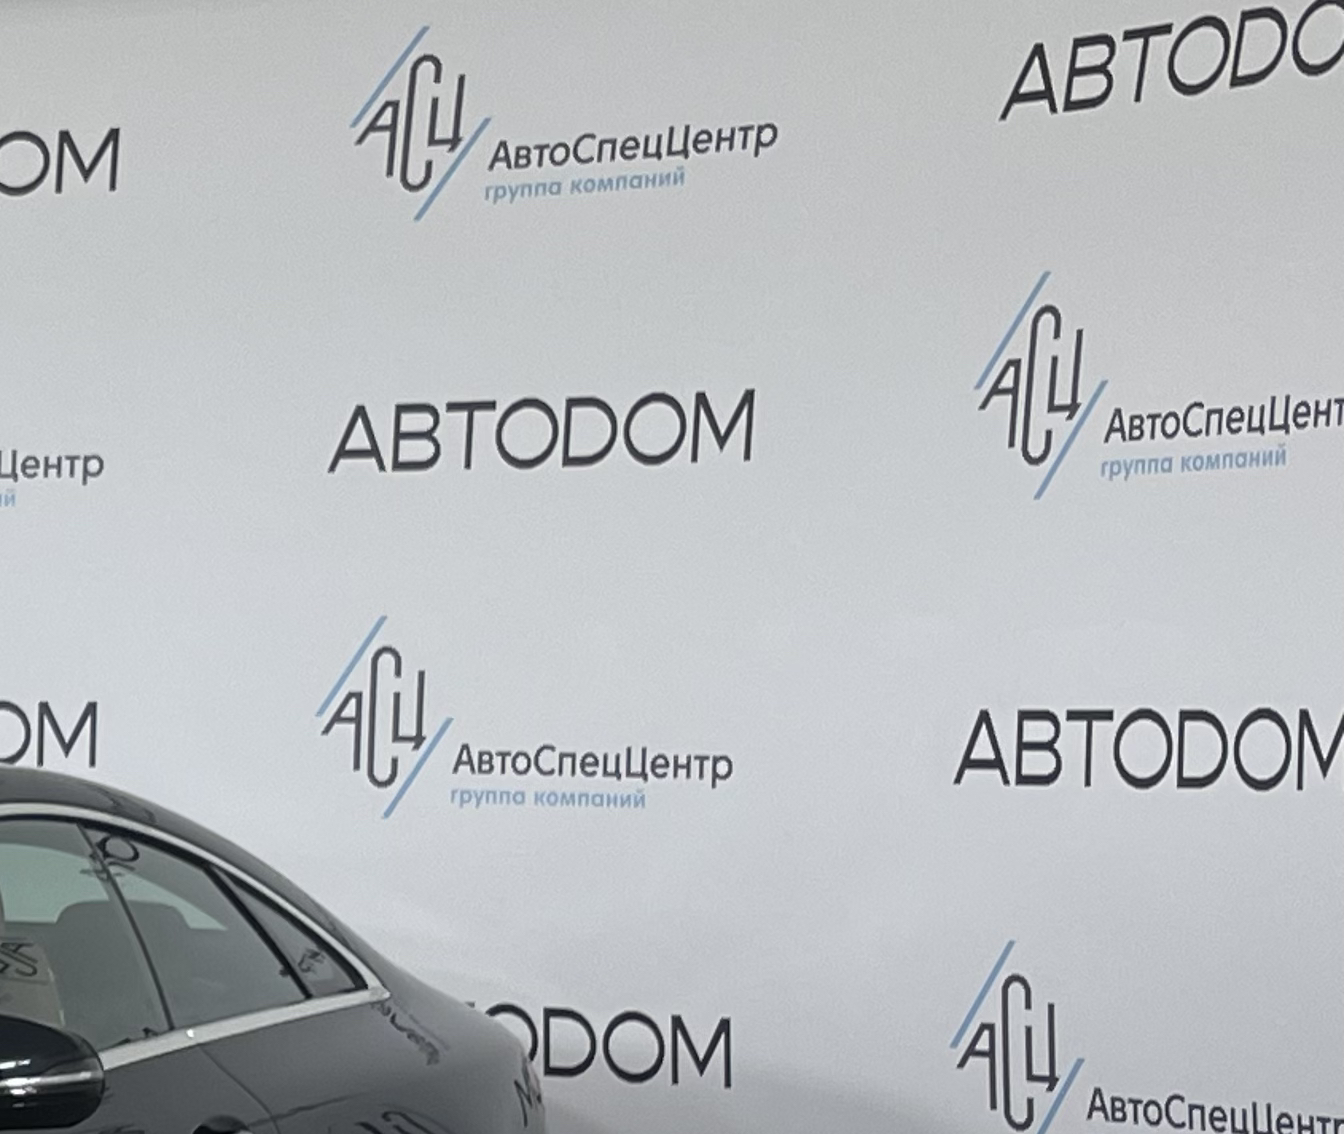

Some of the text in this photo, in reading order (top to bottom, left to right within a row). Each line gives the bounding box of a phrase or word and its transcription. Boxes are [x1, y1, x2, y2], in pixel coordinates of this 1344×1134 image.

[487, 122, 779, 172] АвтоСпецЦентр
[484, 166, 687, 204] группа компаний
[327, 388, 756, 474] ABTODOM
[1100, 443, 1288, 481] группа компаний
[452, 744, 734, 789] АвтоСпецЦентр
[449, 787, 647, 809] группа компаний
